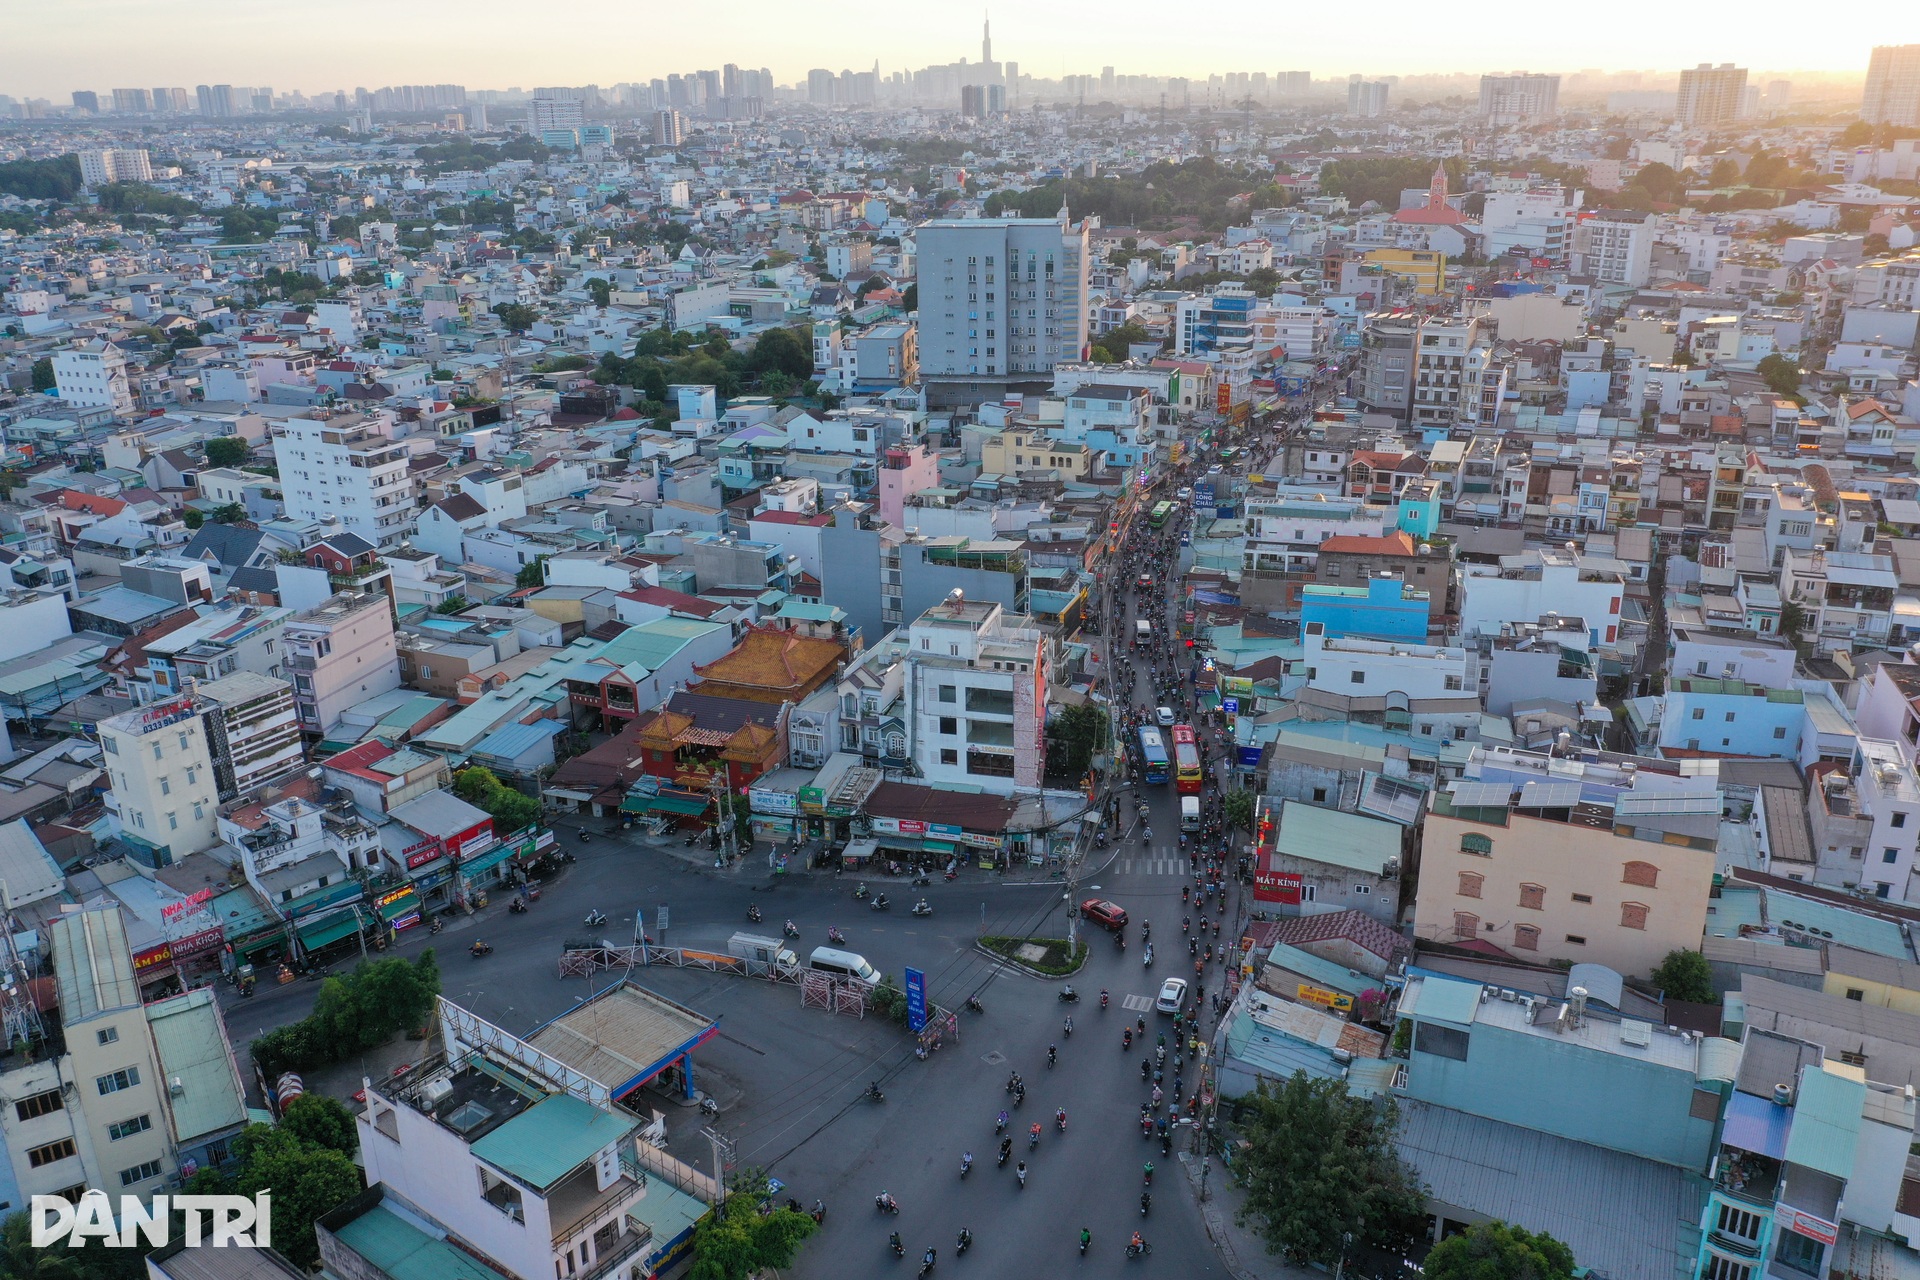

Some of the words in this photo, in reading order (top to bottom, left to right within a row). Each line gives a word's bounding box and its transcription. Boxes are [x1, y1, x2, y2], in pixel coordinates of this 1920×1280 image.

[143, 721, 162, 734] 0333
[403, 845, 415, 854] BAO
[431, 835, 440, 845] SU
[414, 855, 425, 864] OK
[1256, 873, 1276, 885] MẮT
[1277, 876, 1300, 888] KÍNH
[162, 901, 184, 918] NHA
[185, 887, 213, 908] KHOA
[185, 902, 209, 918] MINH
[174, 941, 194, 955] NHA
[195, 931, 222, 947] KHOA
